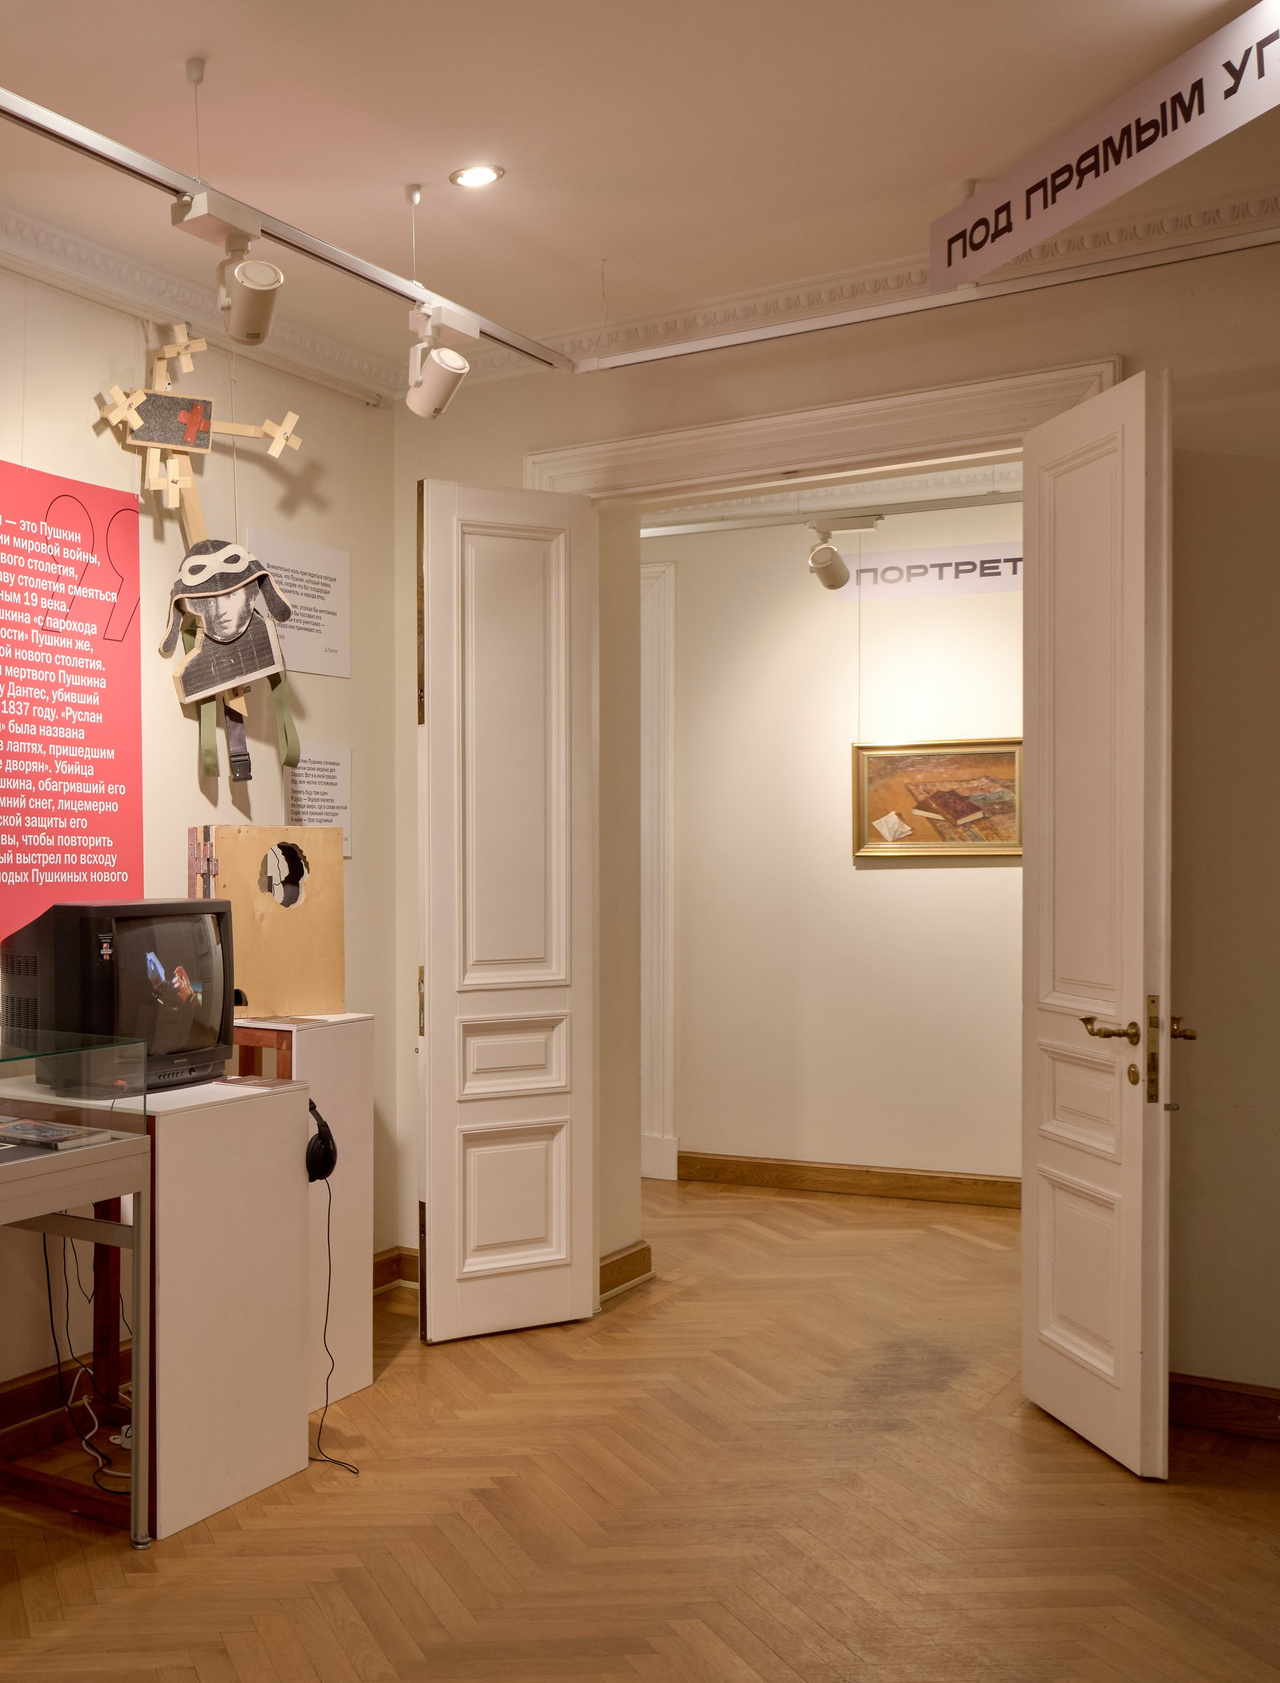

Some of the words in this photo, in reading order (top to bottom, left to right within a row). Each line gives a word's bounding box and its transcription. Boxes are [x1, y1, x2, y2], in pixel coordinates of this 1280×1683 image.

[947, 200, 1013, 268] ПОД
[1025, 77, 1205, 220] ПРЯМЫМ
[12, 536, 60, 556] мировой
[62, 547, 100, 567] войны,
[27, 558, 77, 580] столетия,
[856, 557, 1023, 586] ПОРТРЕТ
[17, 574, 65, 593] столетия
[67, 584, 117, 602] смеяться
[33, 615, 43, 626] «с
[46, 616, 97, 636] парохода
[14, 648, 52, 663] нового
[54, 654, 105, 671] столетия.
[7, 681, 49, 702] Дантес,
[51, 688, 99, 705] убивший
[6, 740, 46, 756] лаптях,
[48, 744, 114, 760] пришедшим
[24, 816, 66, 829] защиты
[69, 817, 87, 828] его
[31, 868, 87, 885] Пушкиных
[90, 871, 128, 882] нового
